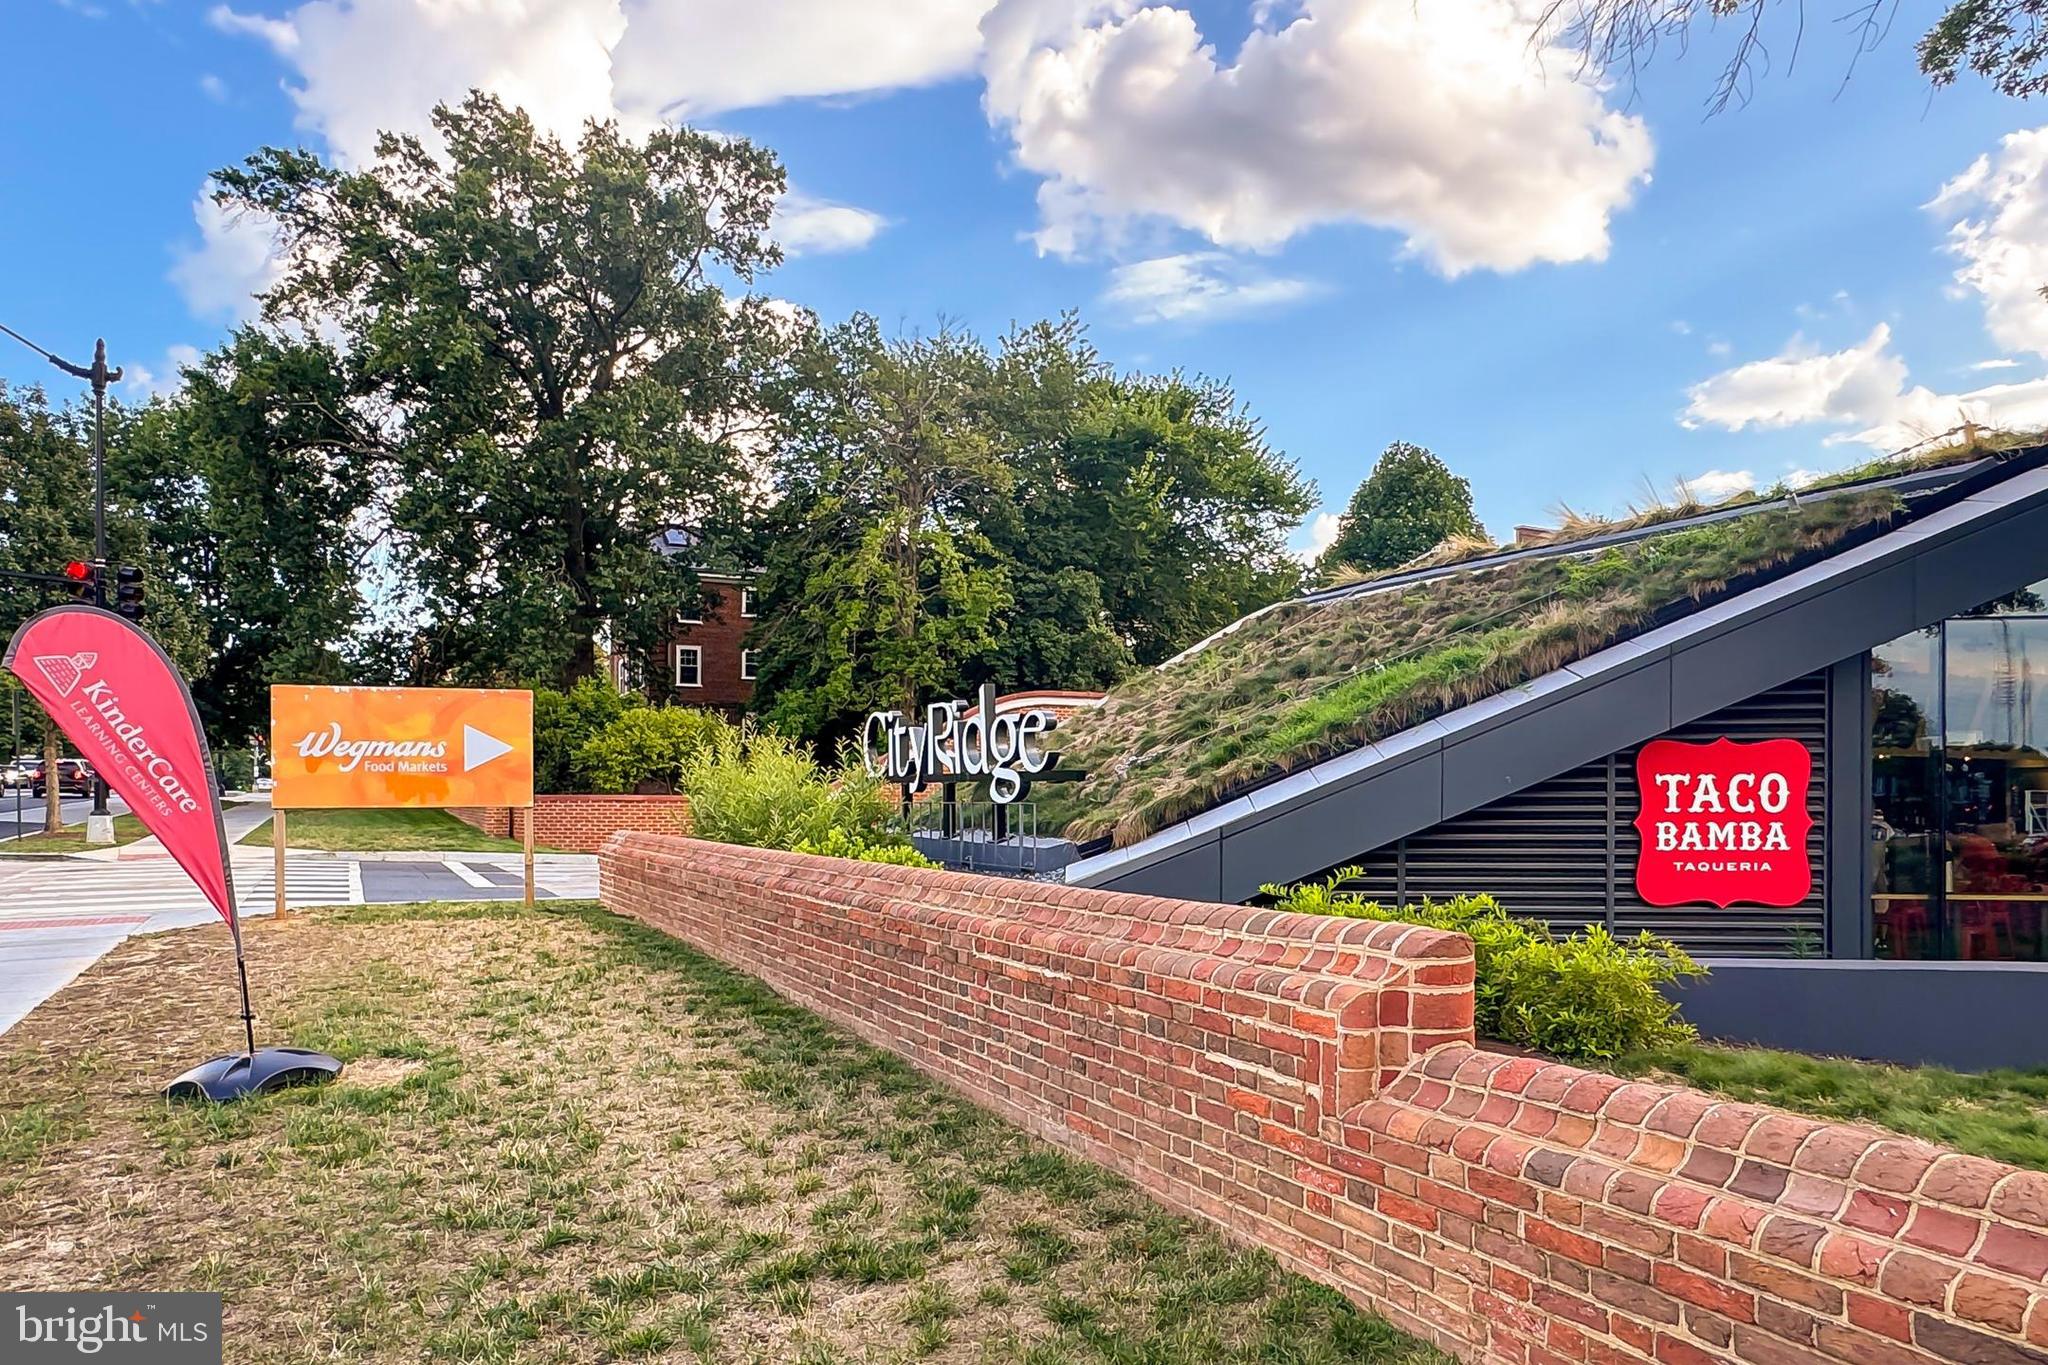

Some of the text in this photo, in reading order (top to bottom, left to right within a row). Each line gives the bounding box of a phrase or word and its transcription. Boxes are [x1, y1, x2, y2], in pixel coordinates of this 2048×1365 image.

[69, 700, 173, 817] LEARNING CENTERS
[82, 679, 198, 813] KinderCare
[291, 721, 448, 772] Wegmans
[364, 760, 448, 773] Food Markets
[1655, 772, 1791, 814] TACO
[1655, 821, 1791, 852] BAMBA
[1673, 861, 1772, 872] TAQUERIA
